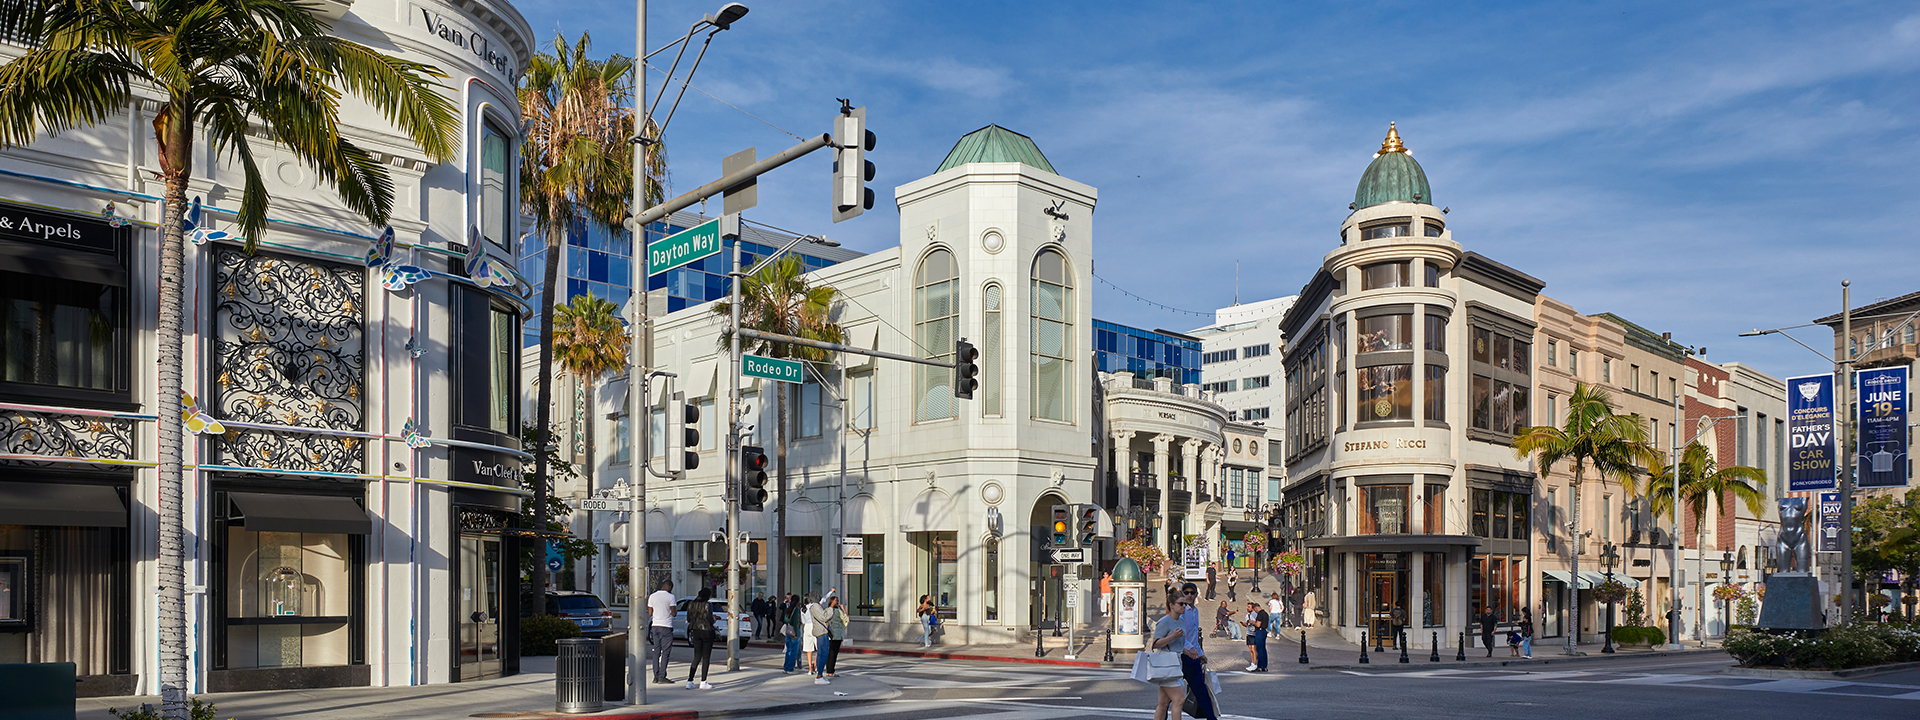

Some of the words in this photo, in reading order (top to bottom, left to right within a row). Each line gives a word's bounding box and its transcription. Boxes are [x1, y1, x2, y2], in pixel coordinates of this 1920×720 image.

[421, 8, 463, 47] Van
[470, 32, 508, 76] Cleef
[0, 216, 14, 229] &
[18, 216, 82, 240] Arpels
[653, 243, 690, 267] Dayton
[692, 233, 715, 251] Way
[747, 360, 782, 376] Rodeo
[785, 365, 798, 378] Dr
[1865, 390, 1902, 403] JUNE
[1793, 407, 1828, 415] CONCOURS
[1791, 424, 1831, 433] FATHER'S
[1344, 440, 1390, 453] STEFANO
[1395, 438, 1427, 449] RICCI
[1792, 431, 1831, 448] DAY
[1799, 449, 1824, 459] CAR
[472, 460, 493, 477] Van
[494, 463, 513, 479] Cleef
[1792, 459, 1831, 471] SHOW
[583, 500, 607, 510] RODEO
[1823, 506, 1841, 514] DAY
